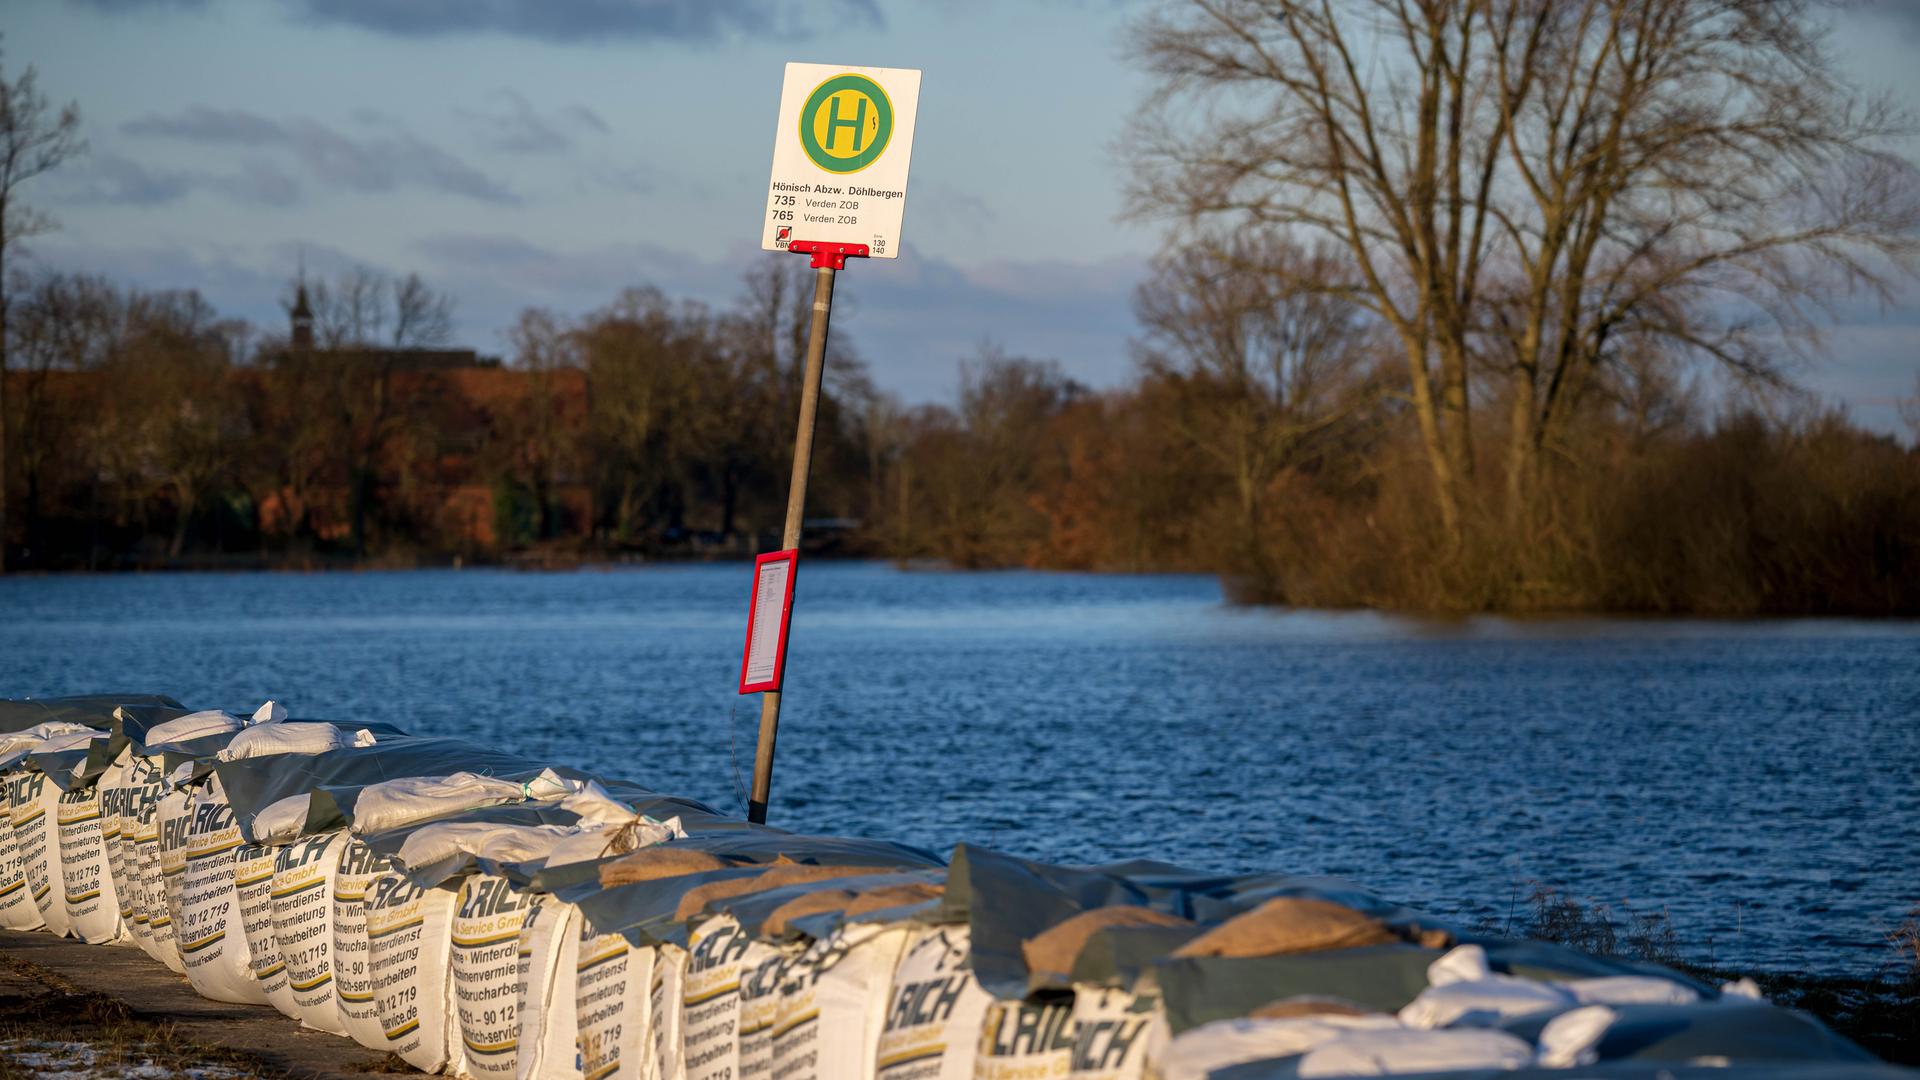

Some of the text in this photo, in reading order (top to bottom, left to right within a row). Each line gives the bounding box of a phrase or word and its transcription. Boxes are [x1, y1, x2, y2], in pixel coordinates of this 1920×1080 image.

[825, 96, 867, 151] H
[772, 182, 903, 199] Hönisch Abzw. Döhlbergen
[774, 195, 859, 210] 735 Verden ZOB
[772, 209, 857, 225] 765 Verden ZOB
[872, 246, 885, 254] 140
[6, 856, 23, 872] 719
[85, 864, 100, 877] 719
[198, 908, 208, 923] 12
[211, 901, 230, 919] 719
[309, 942, 328, 961] 719
[352, 961, 364, 975] 90
[387, 995, 397, 1011] 12
[398, 986, 417, 1004] 719
[483, 1010, 496, 1025] 90
[500, 1005, 514, 1022] 12
[604, 1024, 622, 1045] 719
